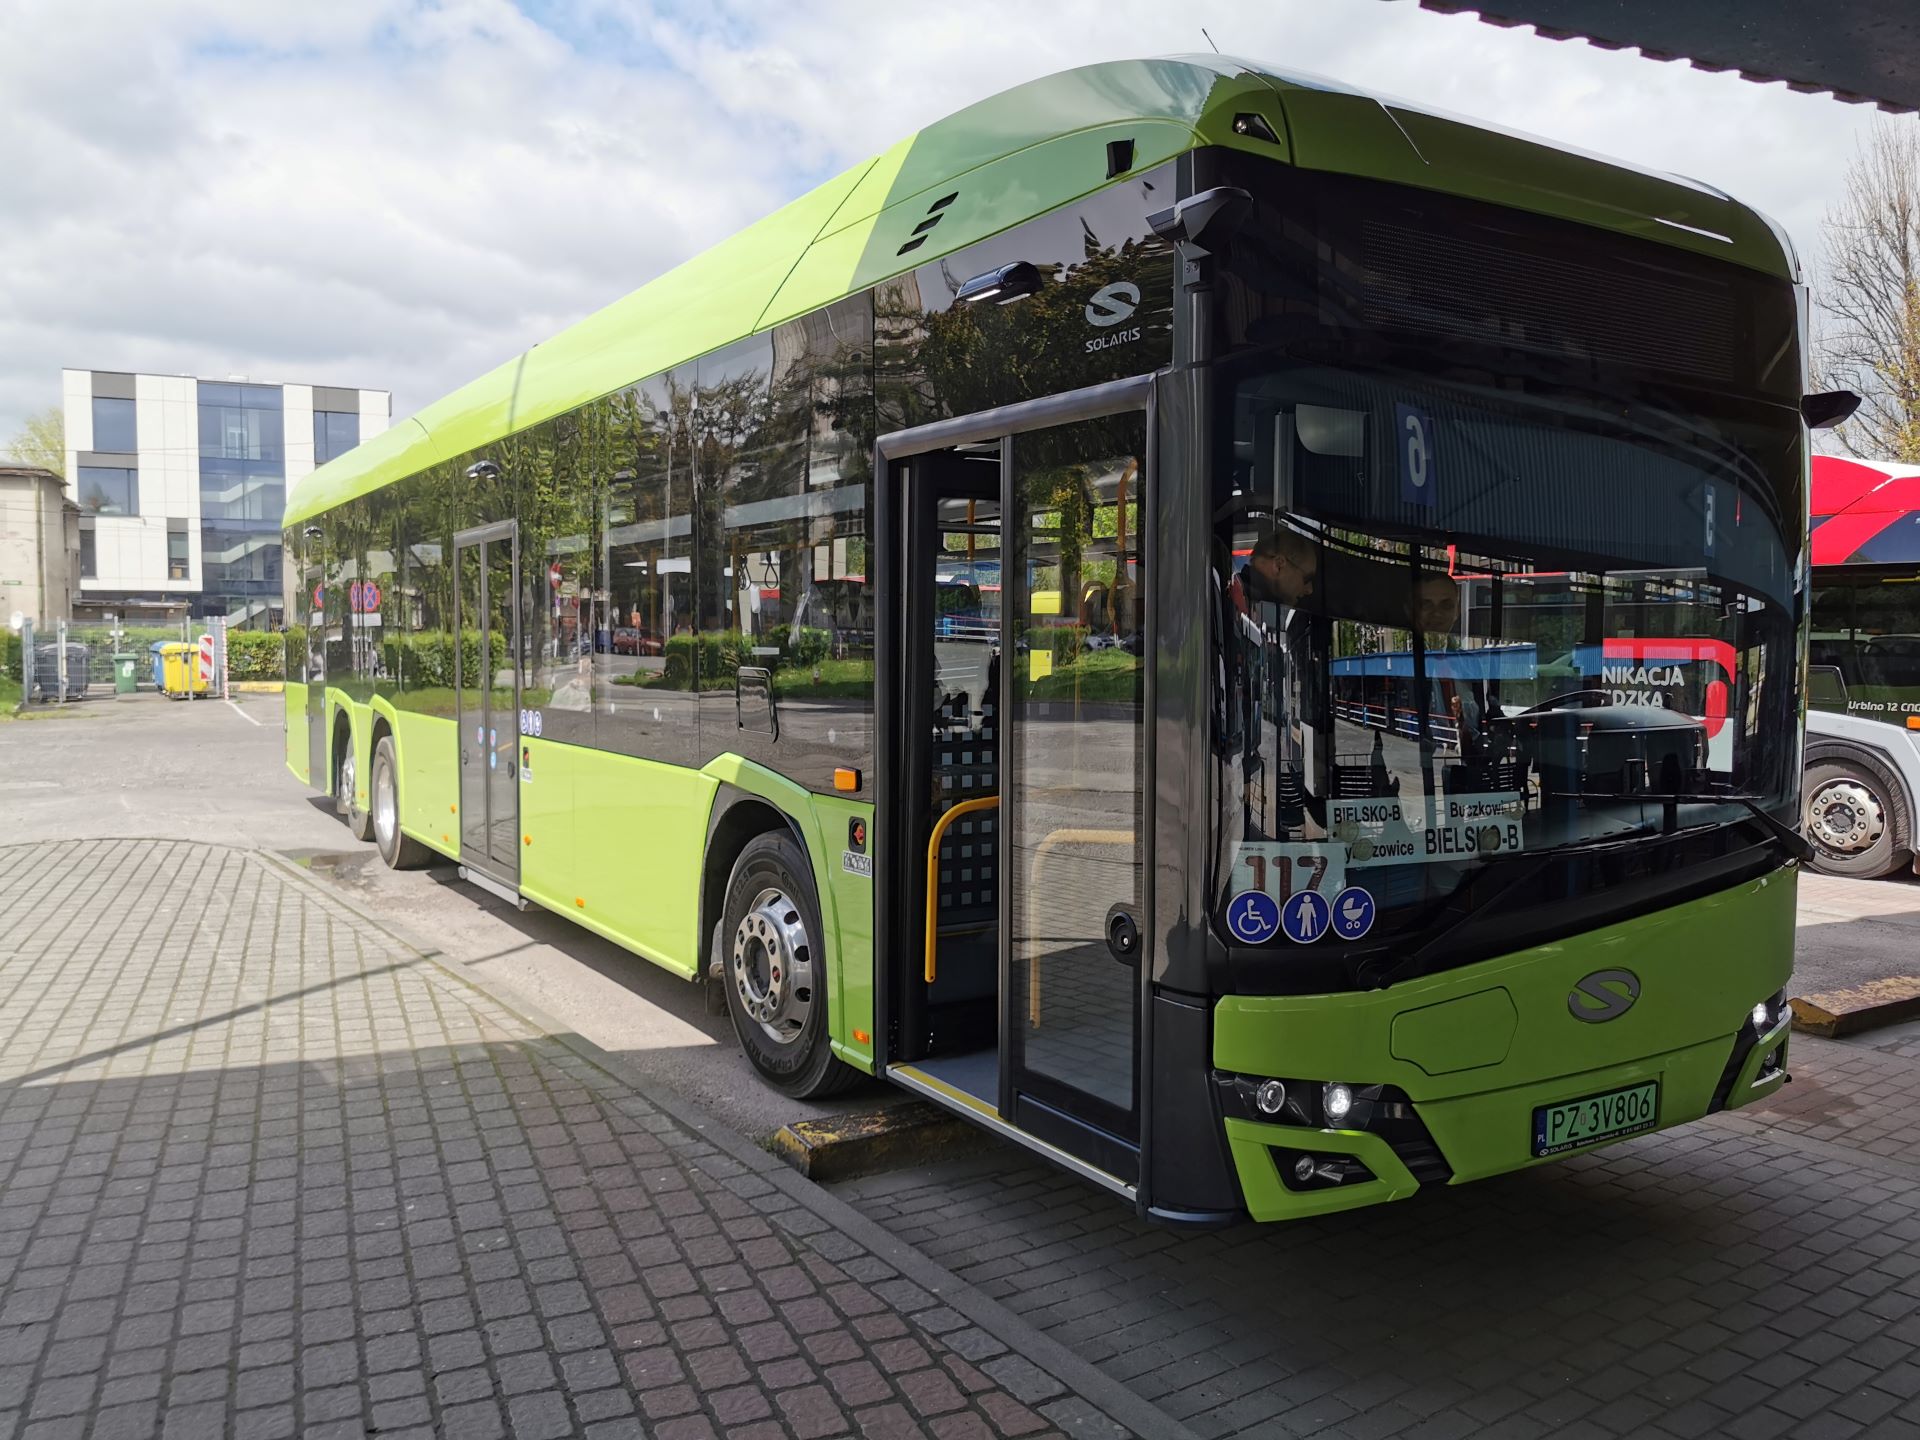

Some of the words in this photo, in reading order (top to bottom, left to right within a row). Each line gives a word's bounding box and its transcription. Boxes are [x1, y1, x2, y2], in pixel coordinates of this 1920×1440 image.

[1085, 327, 1141, 353] SOLARIS
[1602, 665, 1685, 687] NIKACJA
[1604, 689, 1664, 709] DZKA
[1887, 702, 1898, 712] 12
[1333, 804, 1401, 824] BIELSKO-B
[1449, 800, 1506, 818] Buczkowi
[1344, 840, 1415, 865] yzowice
[1245, 855, 1328, 905] 117
[1588, 1087, 1650, 1132] 3V806
